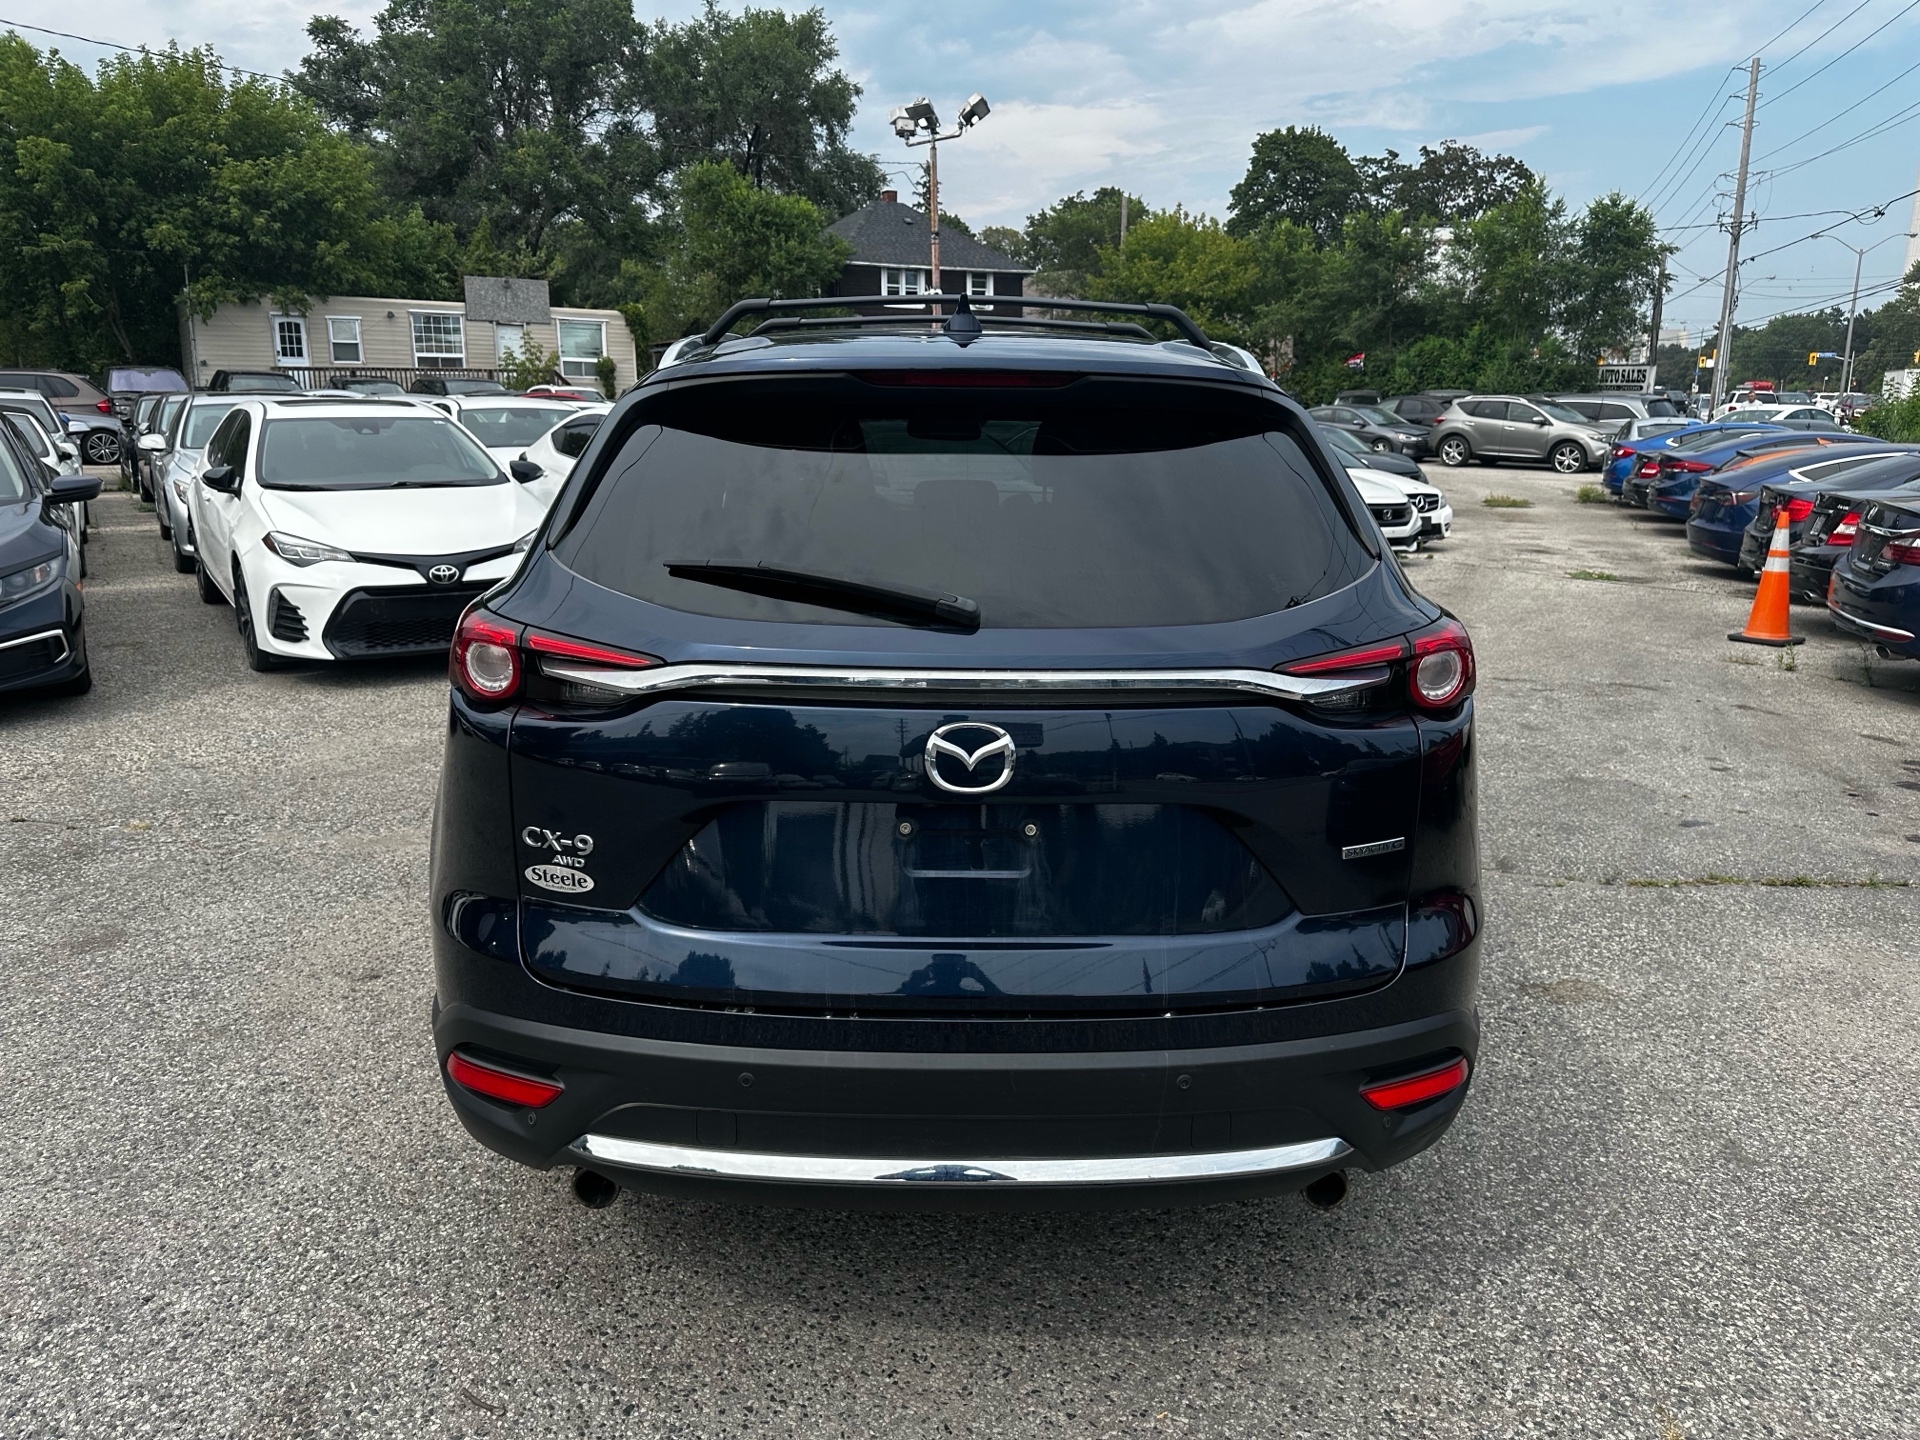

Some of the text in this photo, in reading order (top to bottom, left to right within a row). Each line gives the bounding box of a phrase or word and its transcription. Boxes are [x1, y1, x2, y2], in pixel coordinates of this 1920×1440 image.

[1600, 368, 1647, 384] AUTO SALES
[522, 826, 594, 855] CX-9
[552, 854, 585, 868] AWD
[531, 867, 589, 889] Steele
